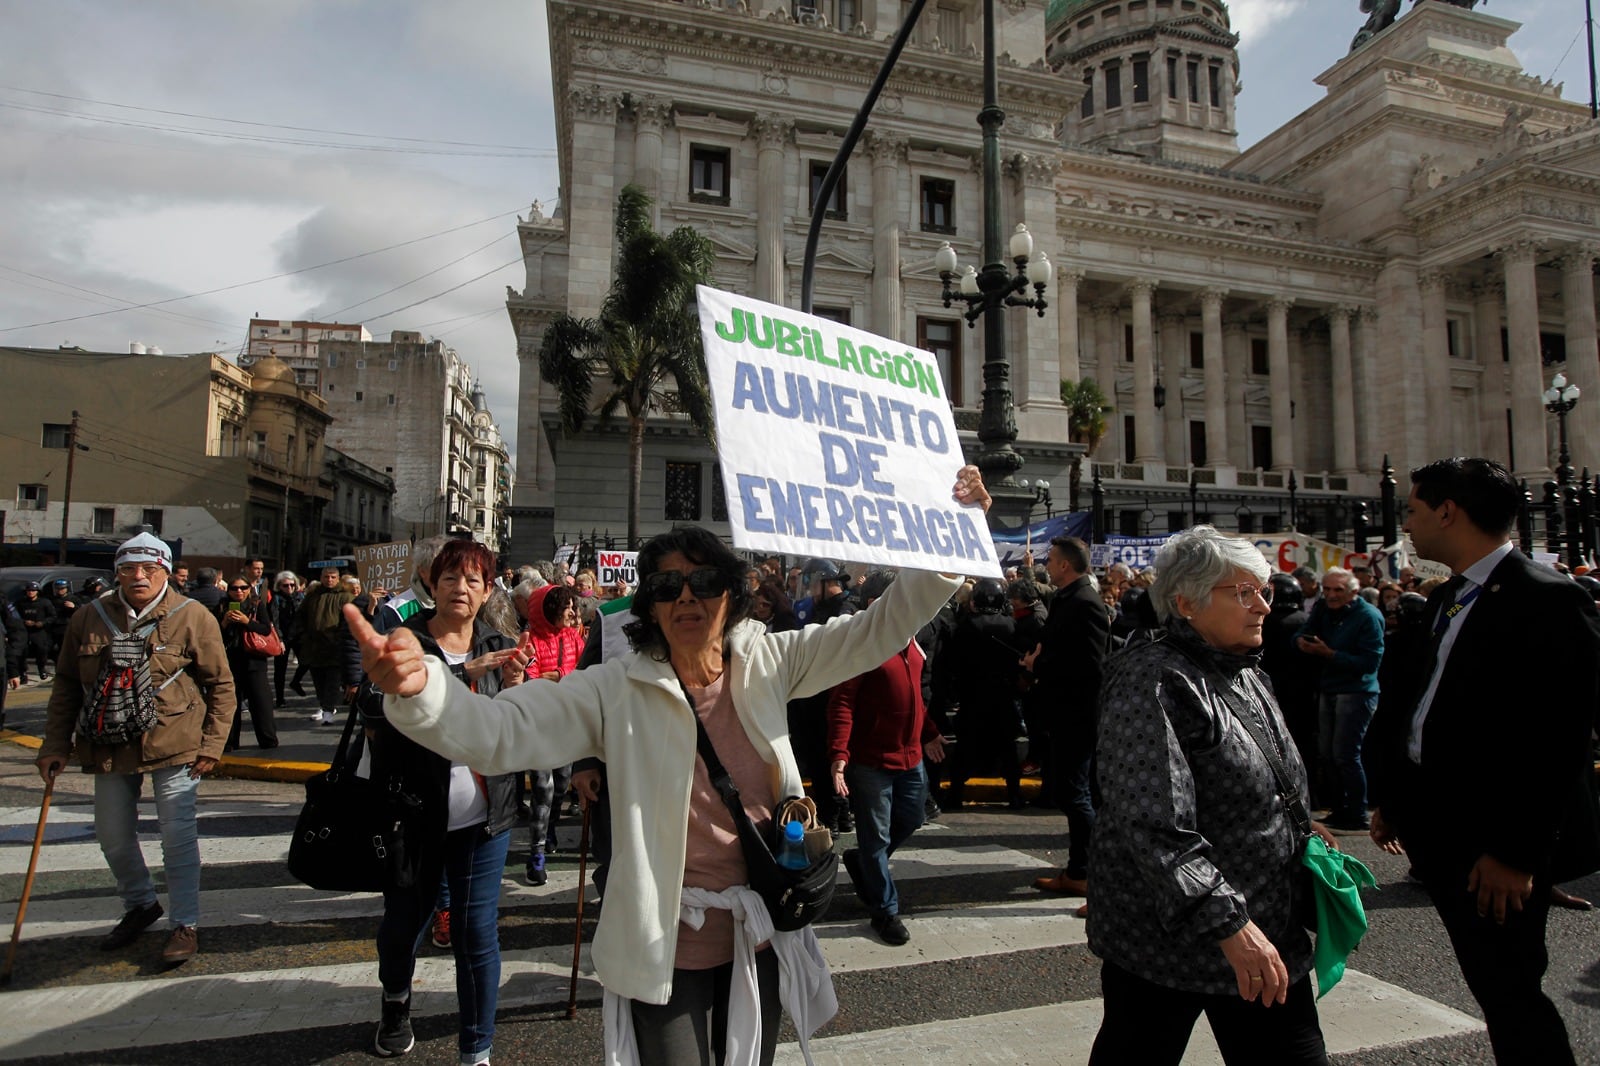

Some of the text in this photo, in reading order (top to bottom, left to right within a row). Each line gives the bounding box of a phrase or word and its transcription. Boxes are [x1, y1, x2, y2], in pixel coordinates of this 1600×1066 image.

[731, 361, 949, 454] AUMENTO
[818, 431, 895, 496] DE
[357, 544, 408, 562] LA PATRIA
[368, 560, 405, 578] NO SE
[624, 559, 636, 567] AL
[603, 568, 635, 583] DNU
[363, 576, 403, 595] VENDE
[1446, 603, 1464, 618] PFA
